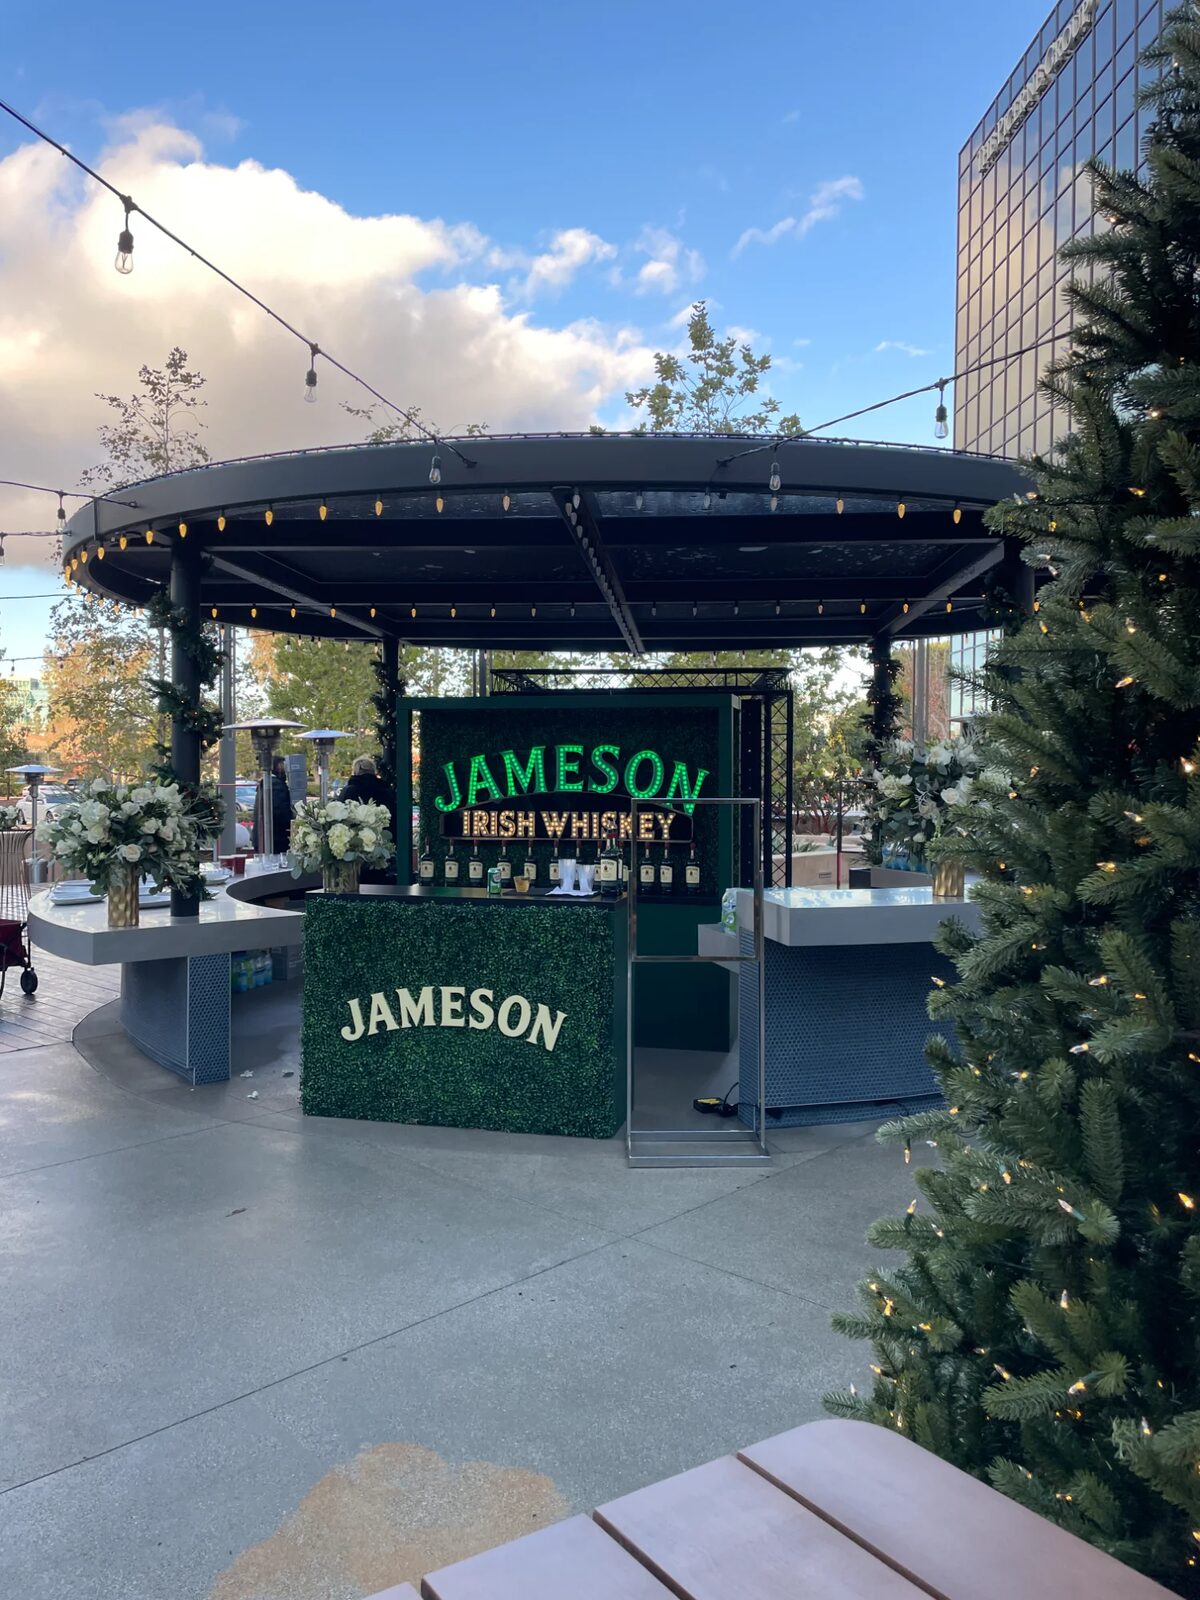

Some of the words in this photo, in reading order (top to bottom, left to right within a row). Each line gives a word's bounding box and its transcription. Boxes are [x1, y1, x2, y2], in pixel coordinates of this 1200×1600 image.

[435, 744, 710, 816] JAMESON
[461, 810, 536, 838] IRISH
[540, 811, 676, 839] WHISKEY
[341, 986, 568, 1051] JAMESON
